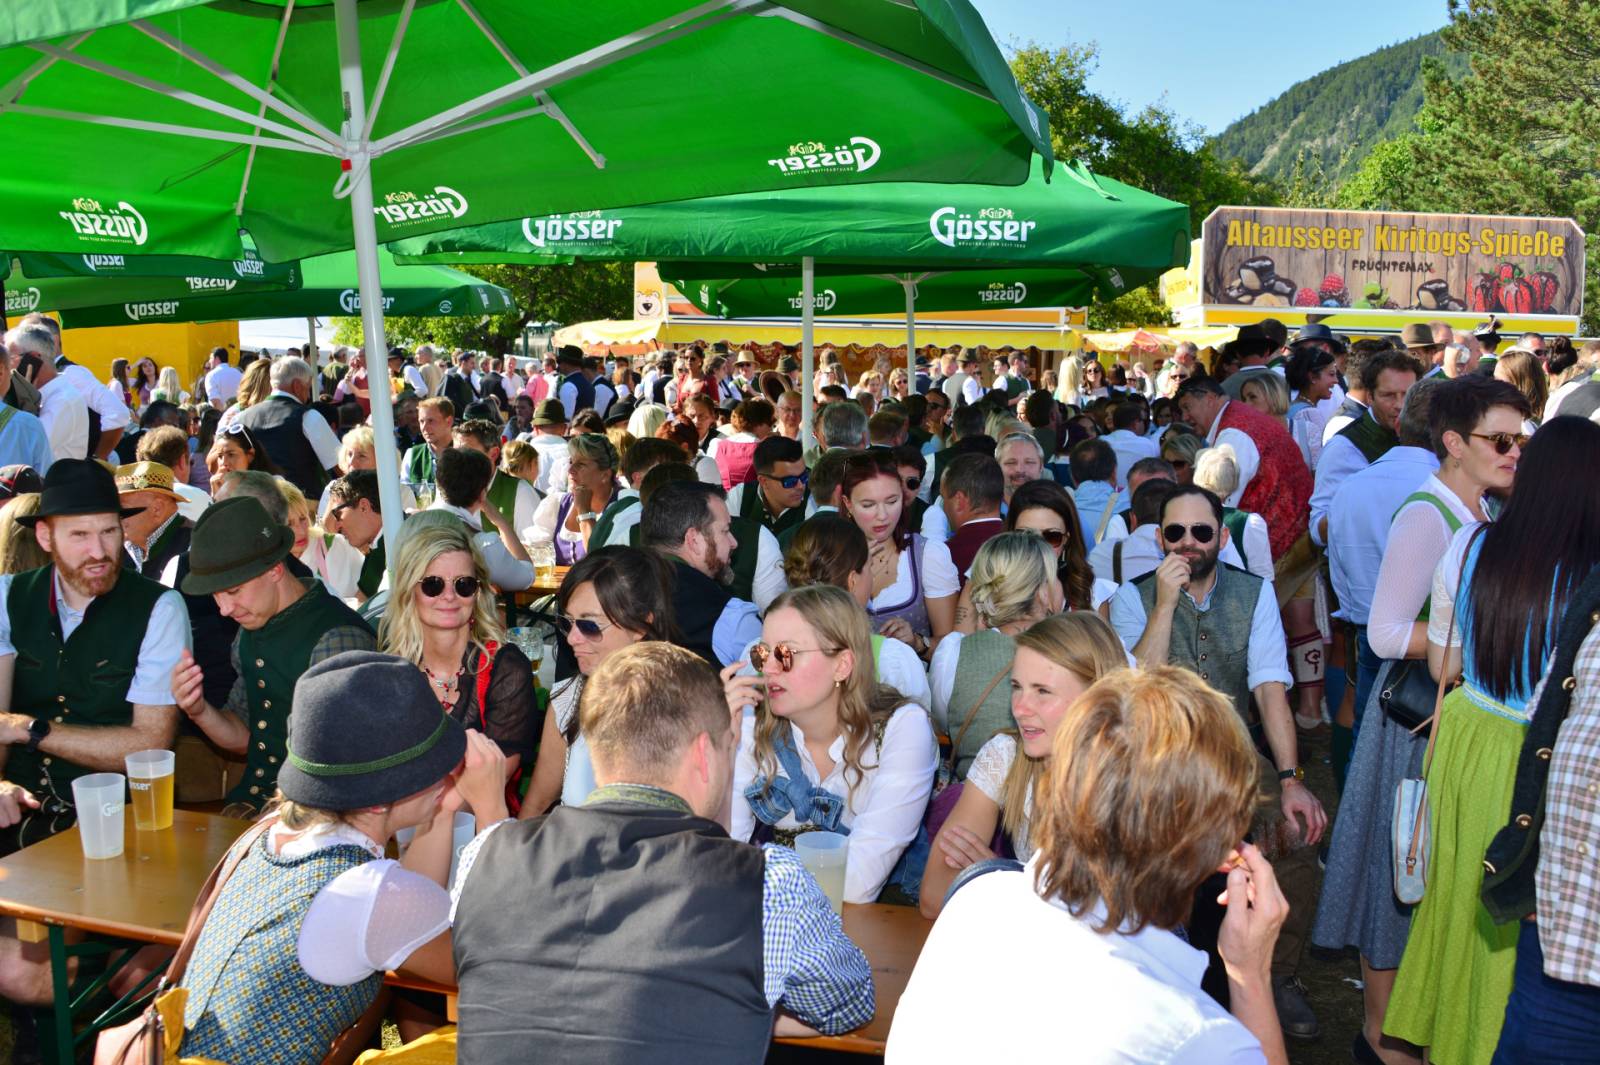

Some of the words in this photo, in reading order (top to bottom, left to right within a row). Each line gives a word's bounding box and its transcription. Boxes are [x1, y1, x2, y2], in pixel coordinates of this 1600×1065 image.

[522, 213, 623, 248] Gösser
[929, 206, 1036, 248] Gösser
[1226, 219, 1364, 250] Altausseer
[1374, 224, 1566, 258] Kiritogs-Spieße
